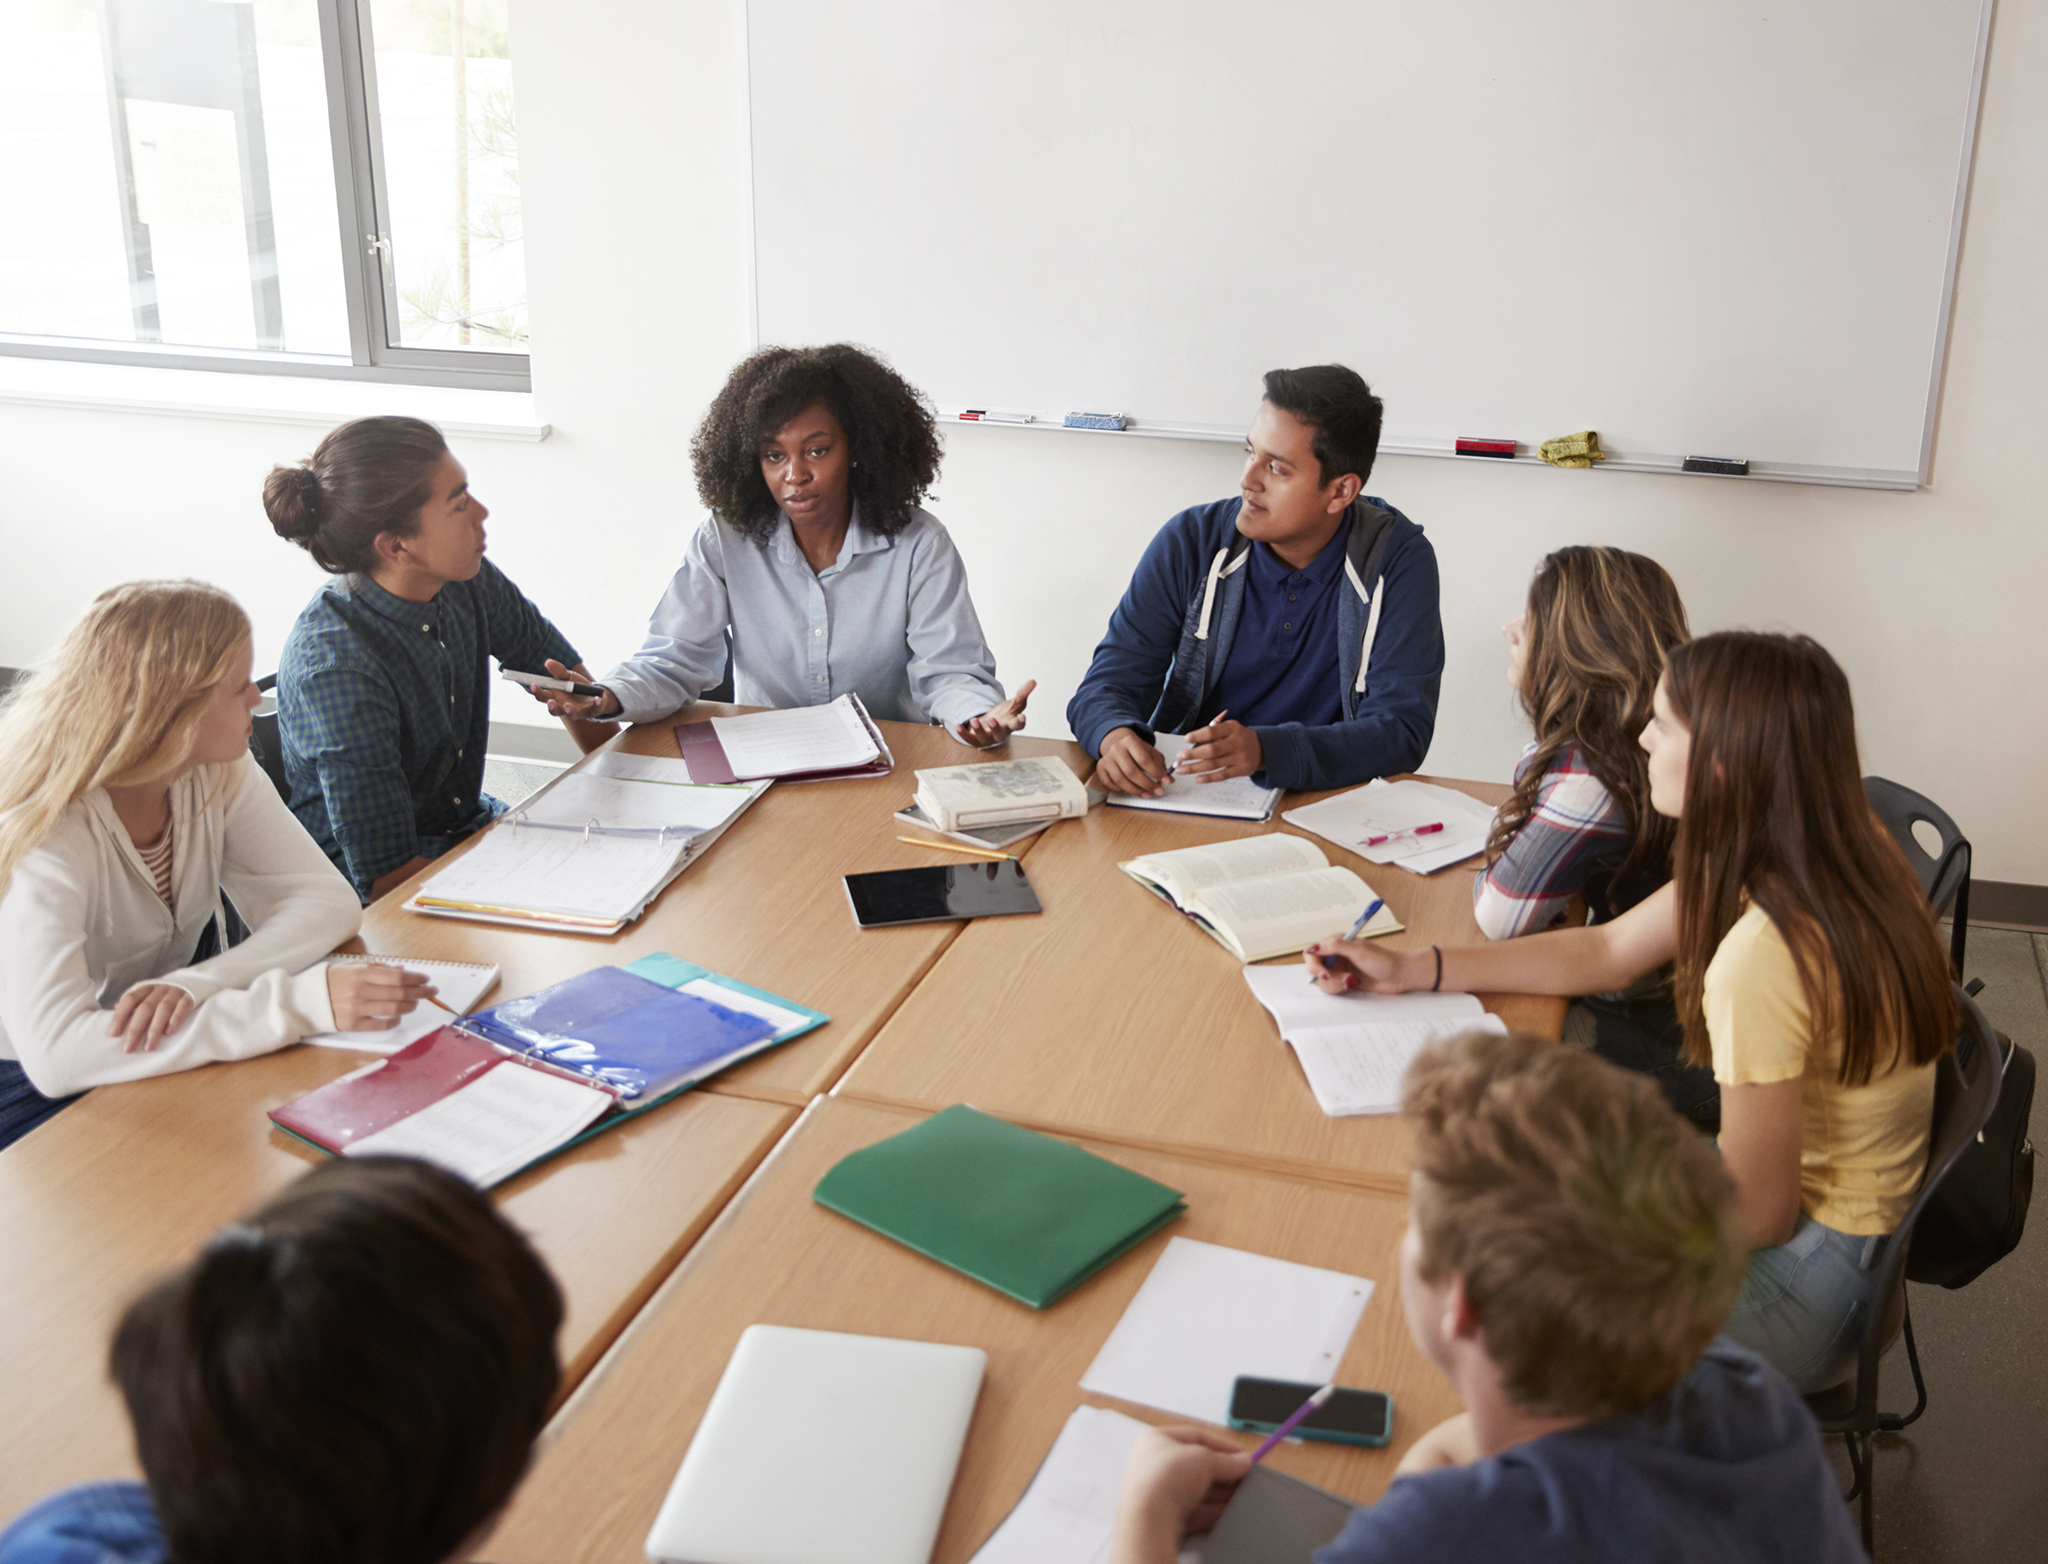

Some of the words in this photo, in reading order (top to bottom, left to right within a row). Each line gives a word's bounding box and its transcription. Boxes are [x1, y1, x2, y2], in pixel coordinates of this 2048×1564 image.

[171, 126, 213, 148] VISITOR
[173, 152, 220, 175] PARKING
[178, 177, 189, 192] AT
[193, 179, 244, 202] ATHLETIC
[180, 200, 233, 225] FACILITIES
